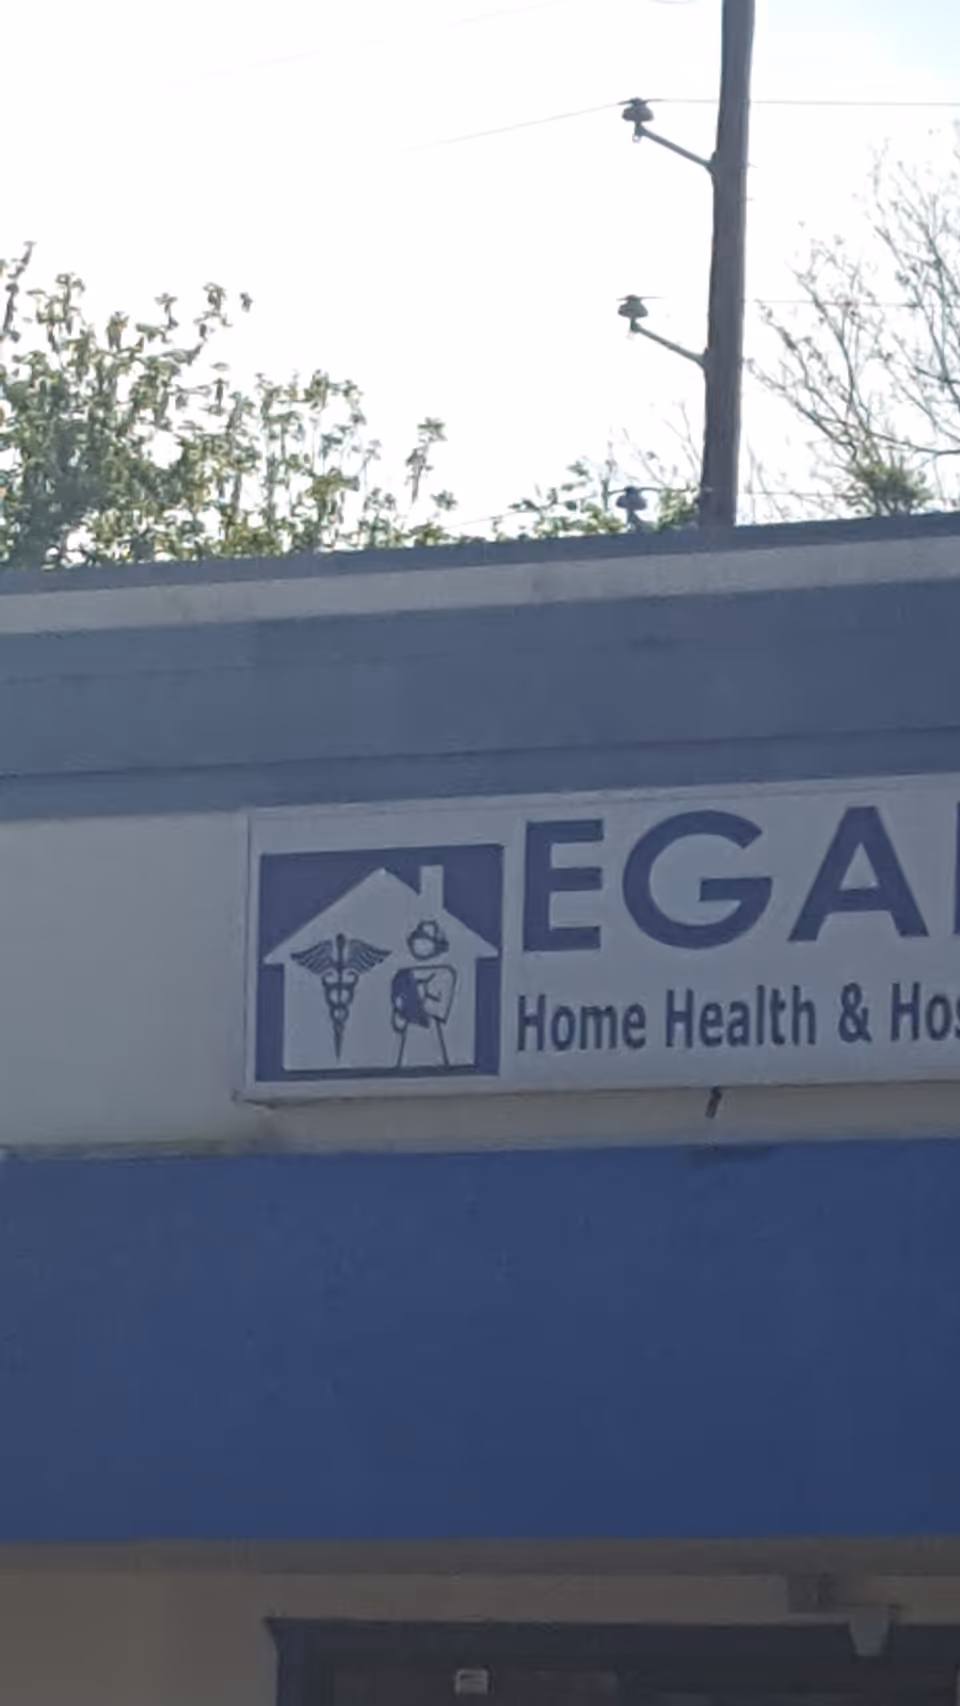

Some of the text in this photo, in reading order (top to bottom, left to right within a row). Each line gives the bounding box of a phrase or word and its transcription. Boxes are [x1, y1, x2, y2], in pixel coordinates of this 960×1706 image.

[517, 995, 647, 1051] Home
[665, 985, 817, 1048] Health
[838, 982, 872, 1043] &
